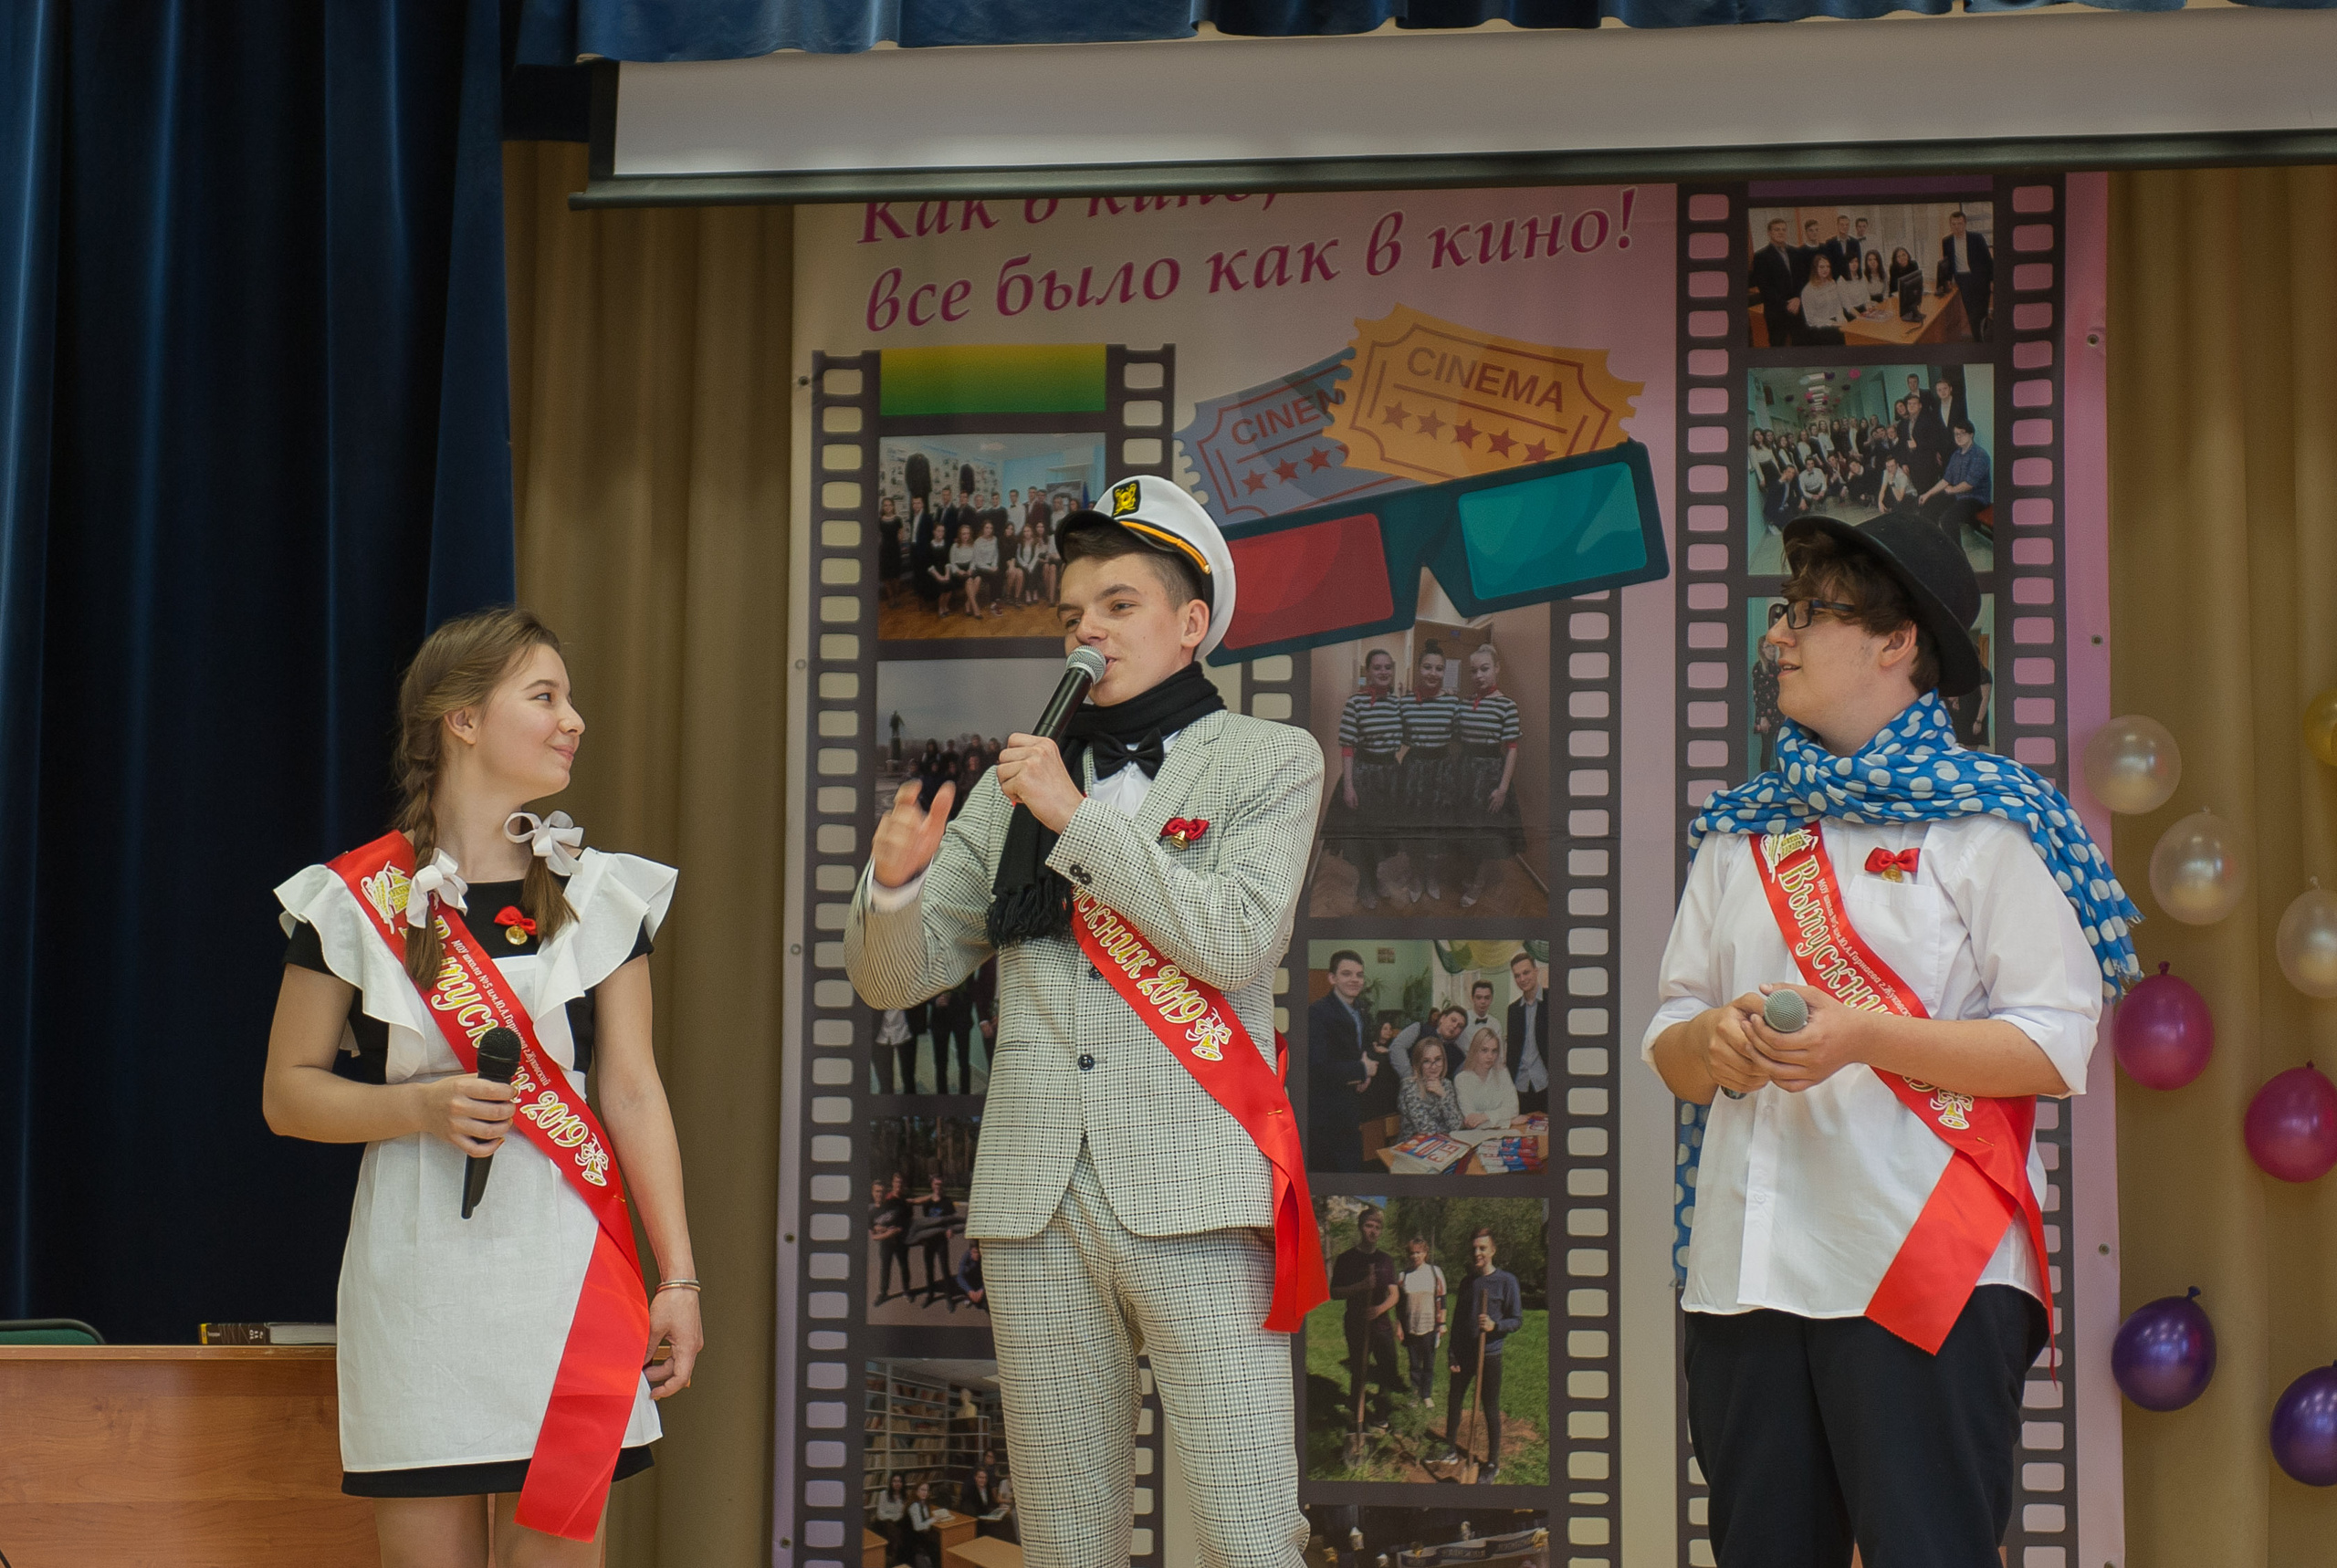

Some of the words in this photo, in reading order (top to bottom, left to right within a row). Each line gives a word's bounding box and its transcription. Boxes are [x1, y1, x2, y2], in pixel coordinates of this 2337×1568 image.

[865, 267, 972, 332] все
[996, 252, 1181, 317] было
[1204, 237, 1341, 294] как
[1366, 210, 1405, 276] в
[1427, 186, 1638, 271] кино!
[1406, 345, 1565, 413] CINEMA
[1230, 387, 1347, 445] CINEM
[450, 939, 470, 955] МОУ
[462, 953, 483, 977] школа
[477, 974, 494, 989] №5
[1777, 853, 1894, 1016] Выпускн
[1136, 964, 1209, 1025] 2019
[519, 1090, 590, 1148] 2019
